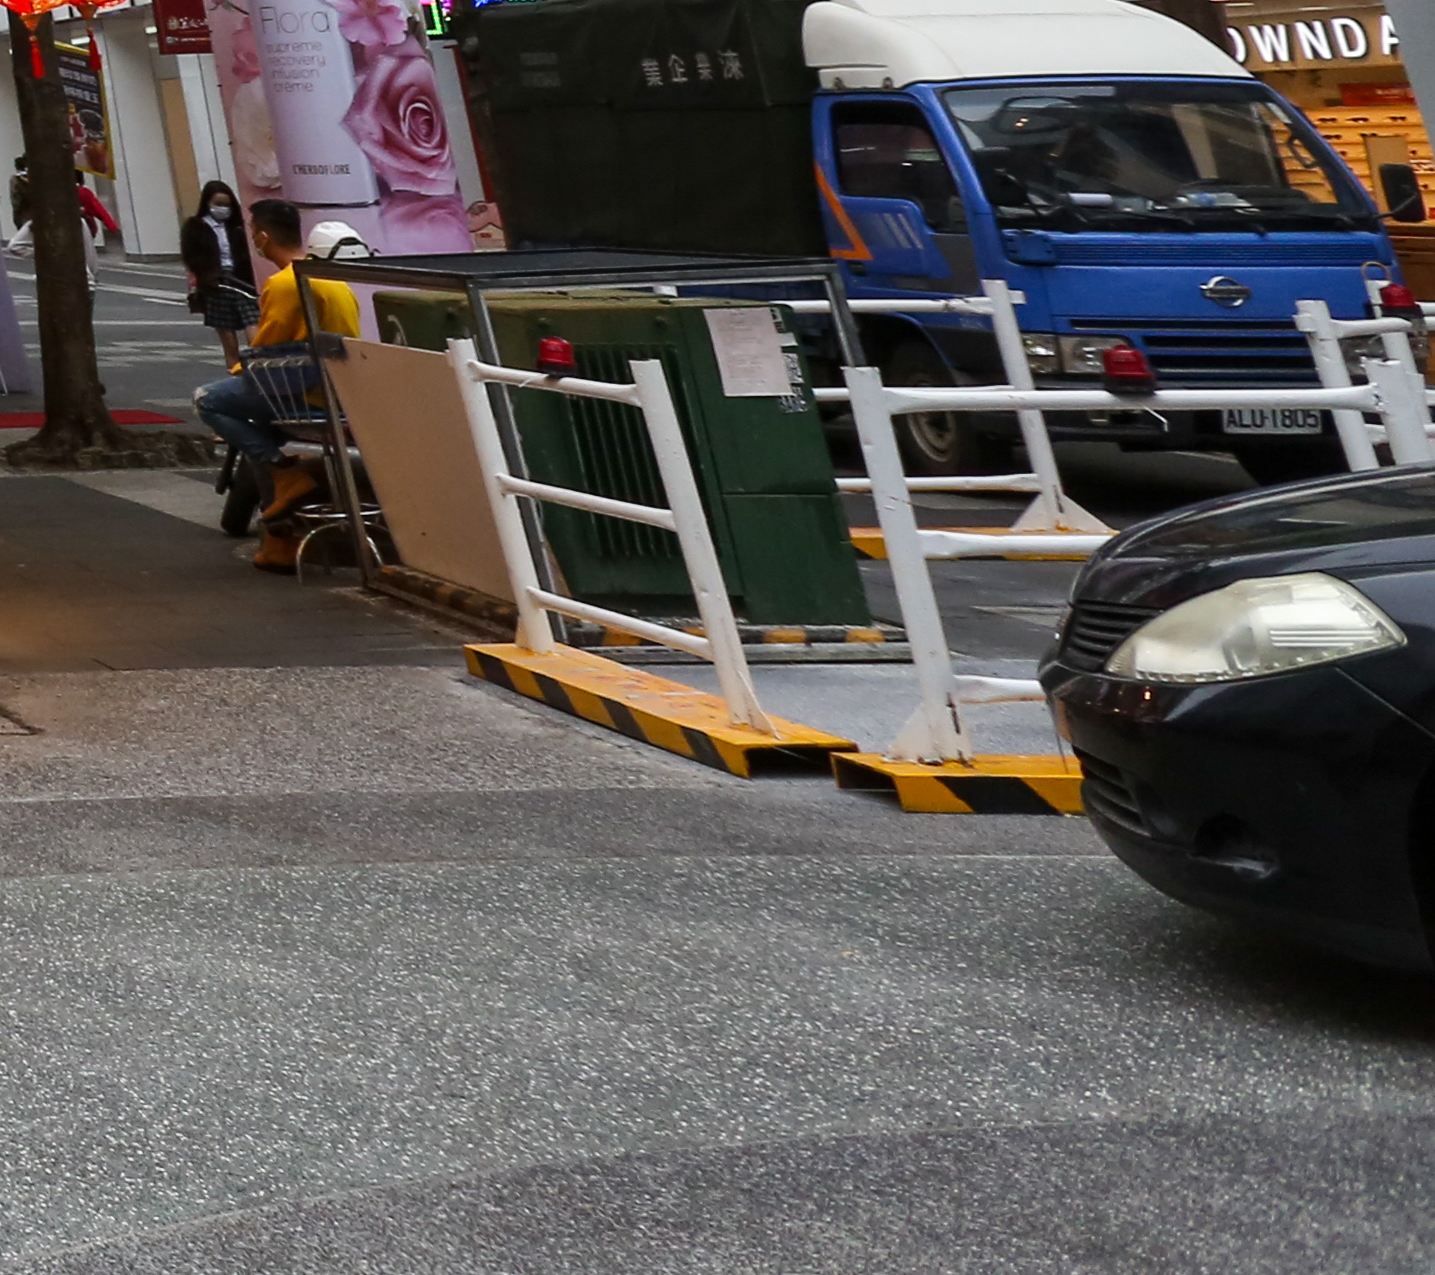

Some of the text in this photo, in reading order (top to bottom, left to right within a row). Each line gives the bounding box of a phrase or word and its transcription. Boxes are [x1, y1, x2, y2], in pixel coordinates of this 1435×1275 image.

[259, 4, 331, 36] Flora
[267, 52, 327, 69] recovery
[270, 66, 321, 80] infusion
